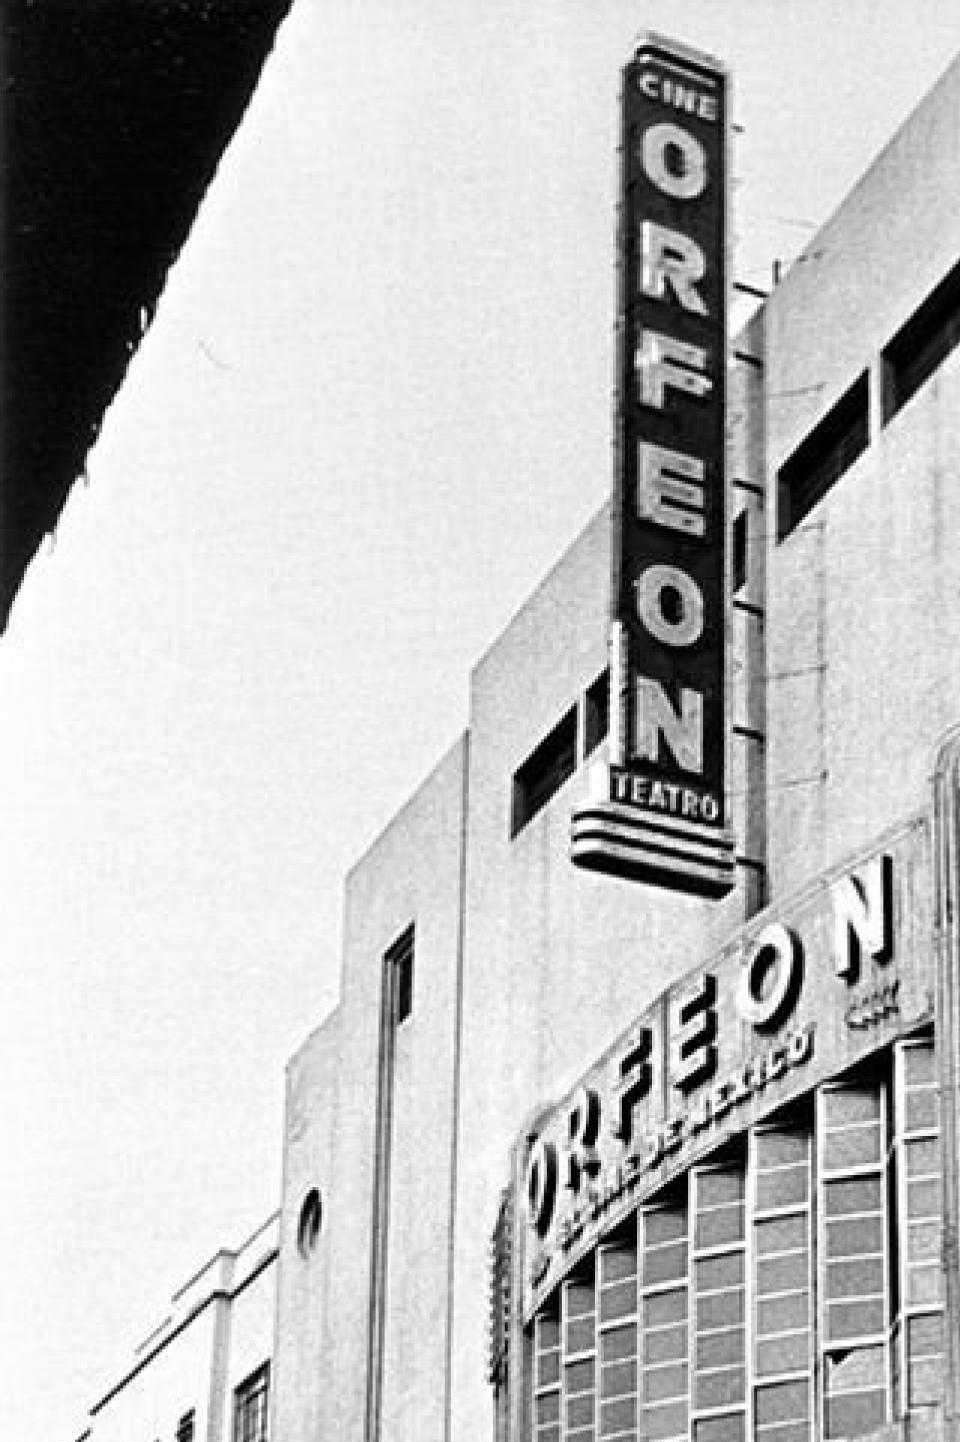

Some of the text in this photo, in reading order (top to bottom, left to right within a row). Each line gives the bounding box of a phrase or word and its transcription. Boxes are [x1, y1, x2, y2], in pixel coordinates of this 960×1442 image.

[637, 72, 718, 121] CINE
[638, 122, 711, 776] ORFEON
[613, 772, 719, 821] TEATRO
[526, 853, 894, 1240] ORFEON
